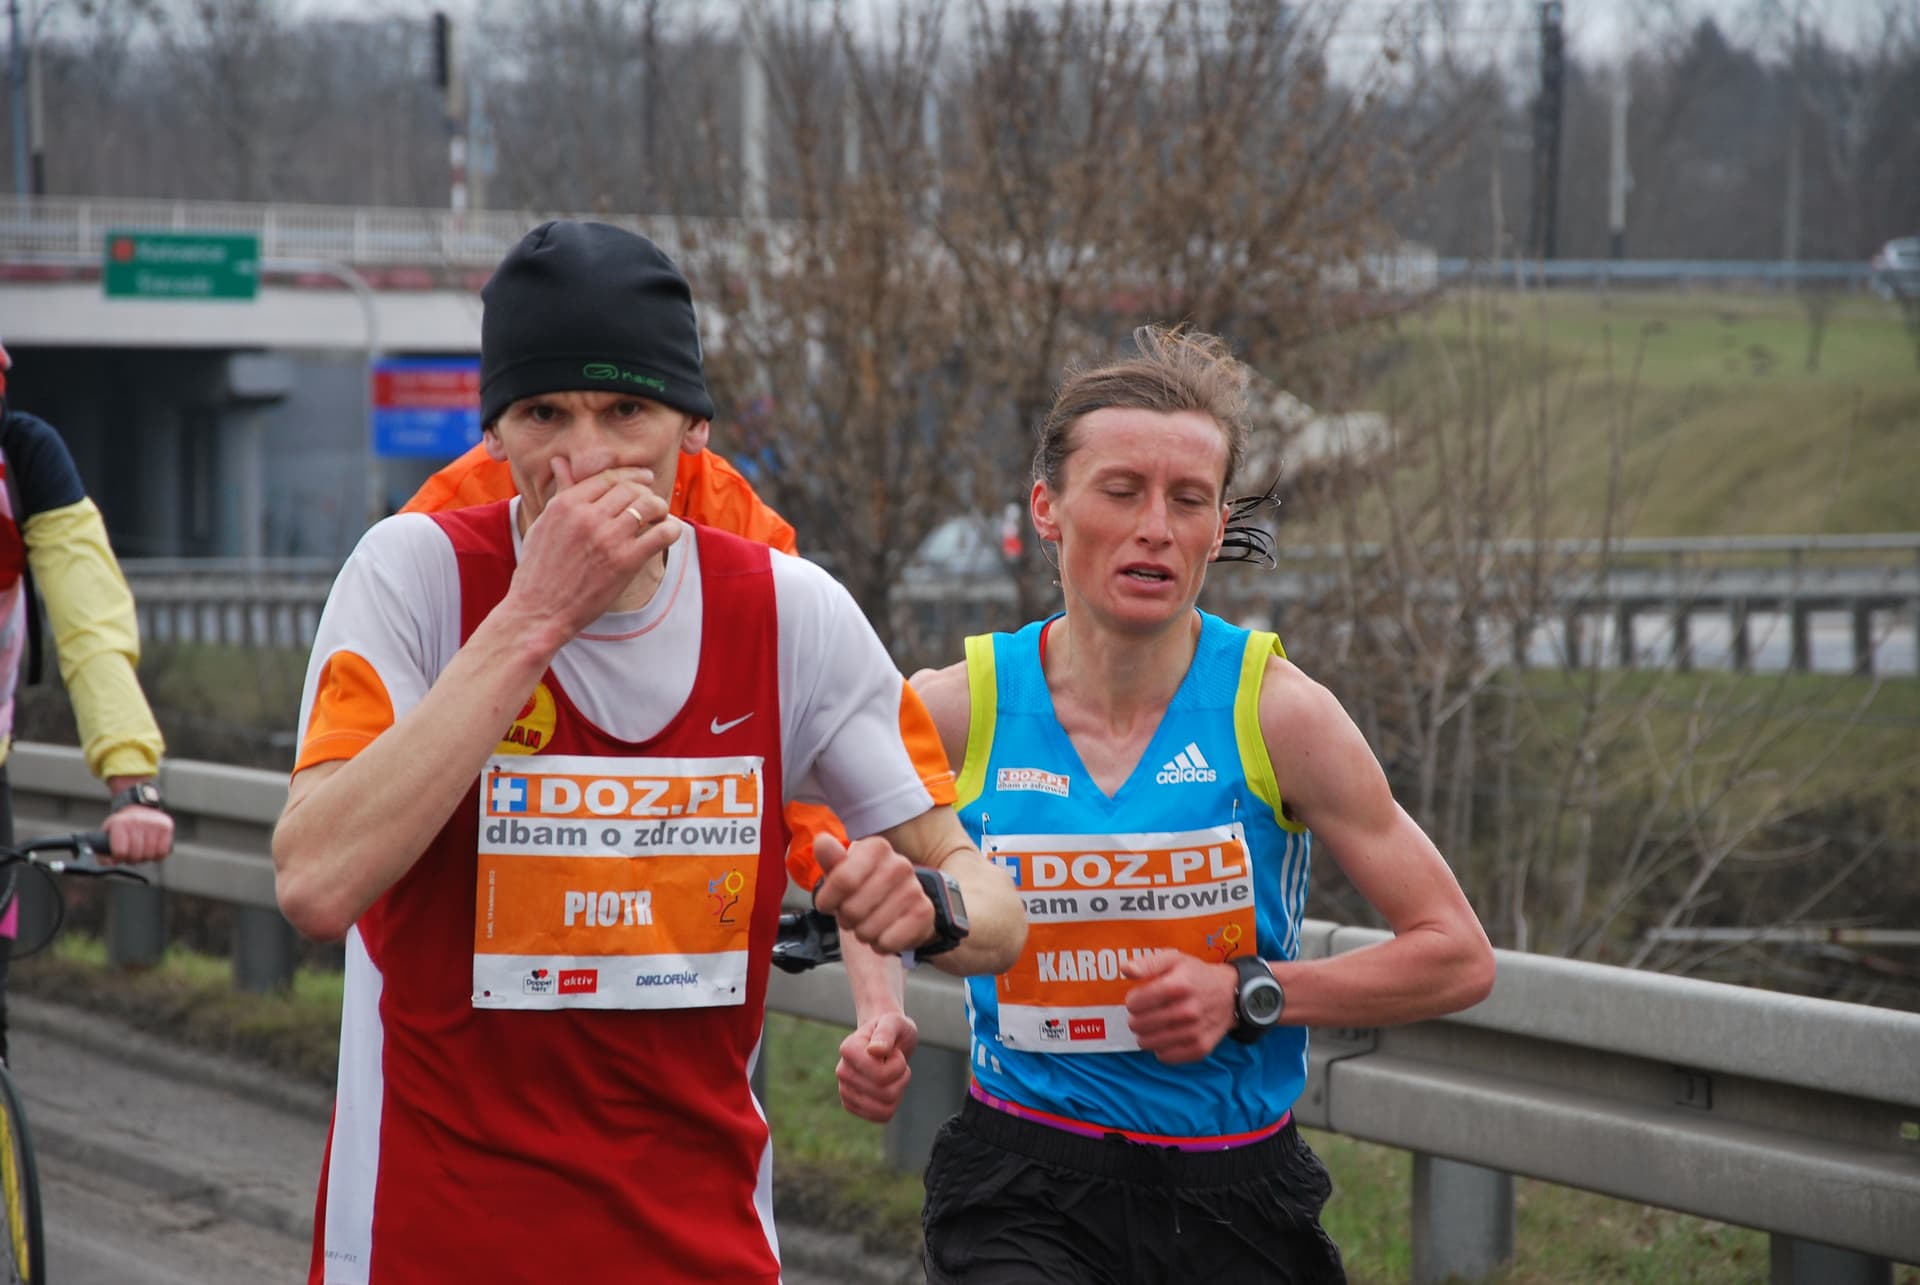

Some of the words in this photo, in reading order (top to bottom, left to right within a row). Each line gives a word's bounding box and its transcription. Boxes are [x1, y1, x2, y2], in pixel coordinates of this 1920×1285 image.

[502, 723, 543, 750] AN
[1156, 766, 1217, 785] adidas
[539, 777, 754, 816] DOZ.PL
[485, 819, 588, 847] dbam
[601, 828, 622, 847] o
[633, 820, 757, 847] zdrowie
[1031, 845, 1244, 888] DOZ.PL
[563, 889, 654, 928] PIOTR
[1022, 897, 1079, 915] am
[1089, 892, 1110, 913] o
[1119, 882, 1250, 912] zdrowie
[563, 975, 593, 987] aktiv
[1074, 1023, 1102, 1034] aktiv
